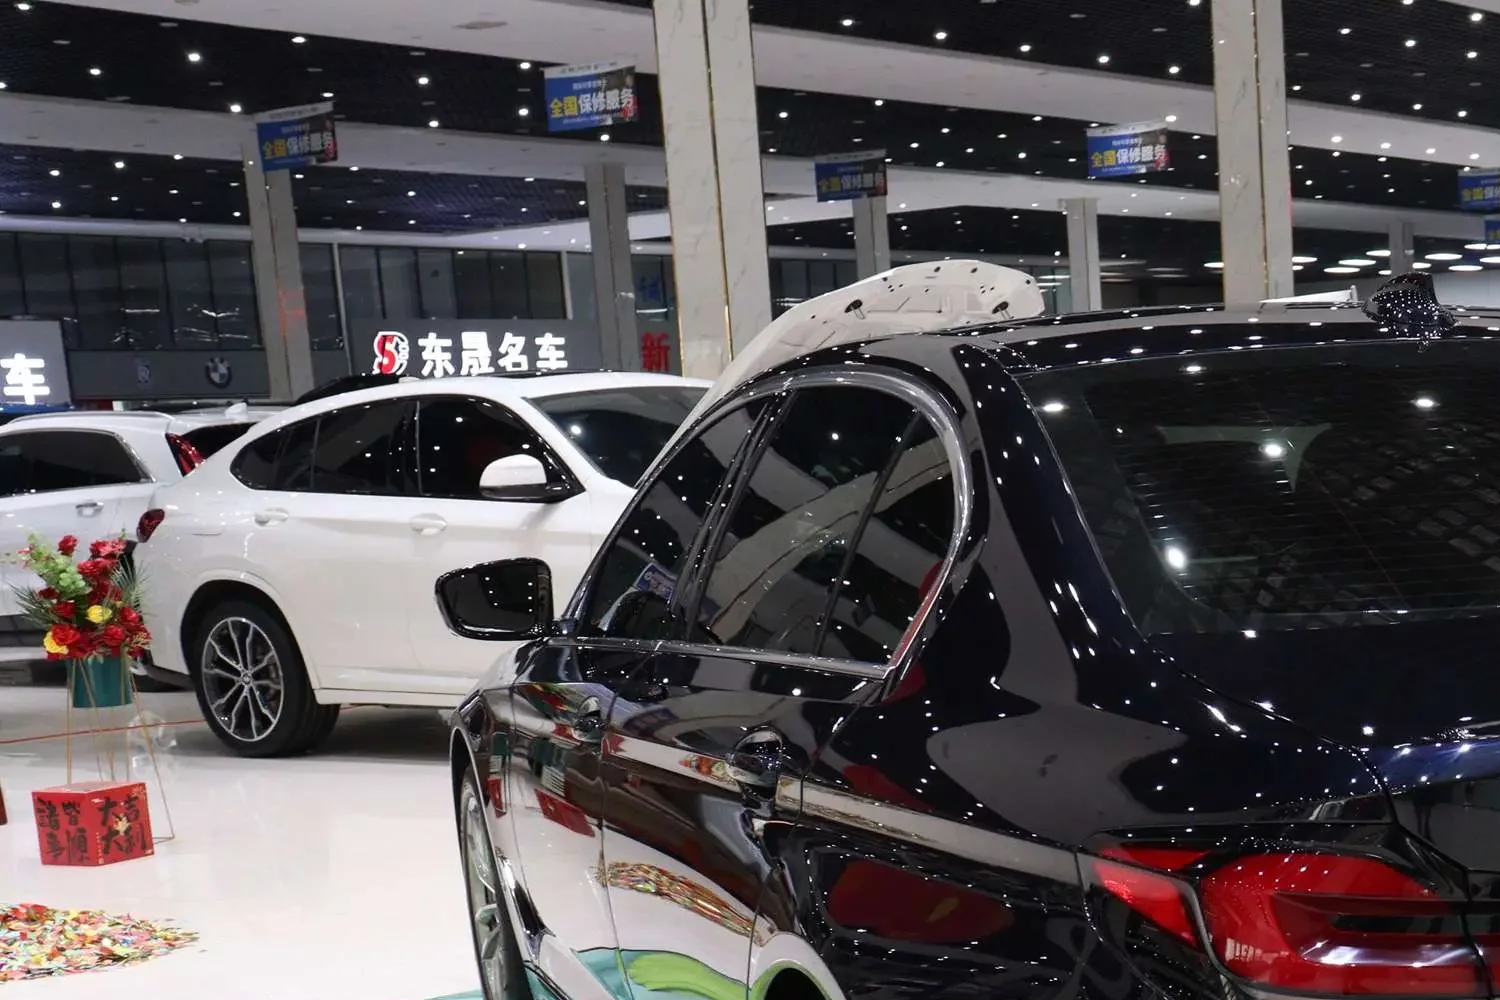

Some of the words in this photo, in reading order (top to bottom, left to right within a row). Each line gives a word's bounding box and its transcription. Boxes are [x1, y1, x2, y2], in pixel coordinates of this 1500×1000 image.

[550, 88, 635, 118] 全国保修服务
[417, 331, 569, 378] 东晟名车
[641, 332, 671, 374] 新
[0, 353, 51, 405] 车
